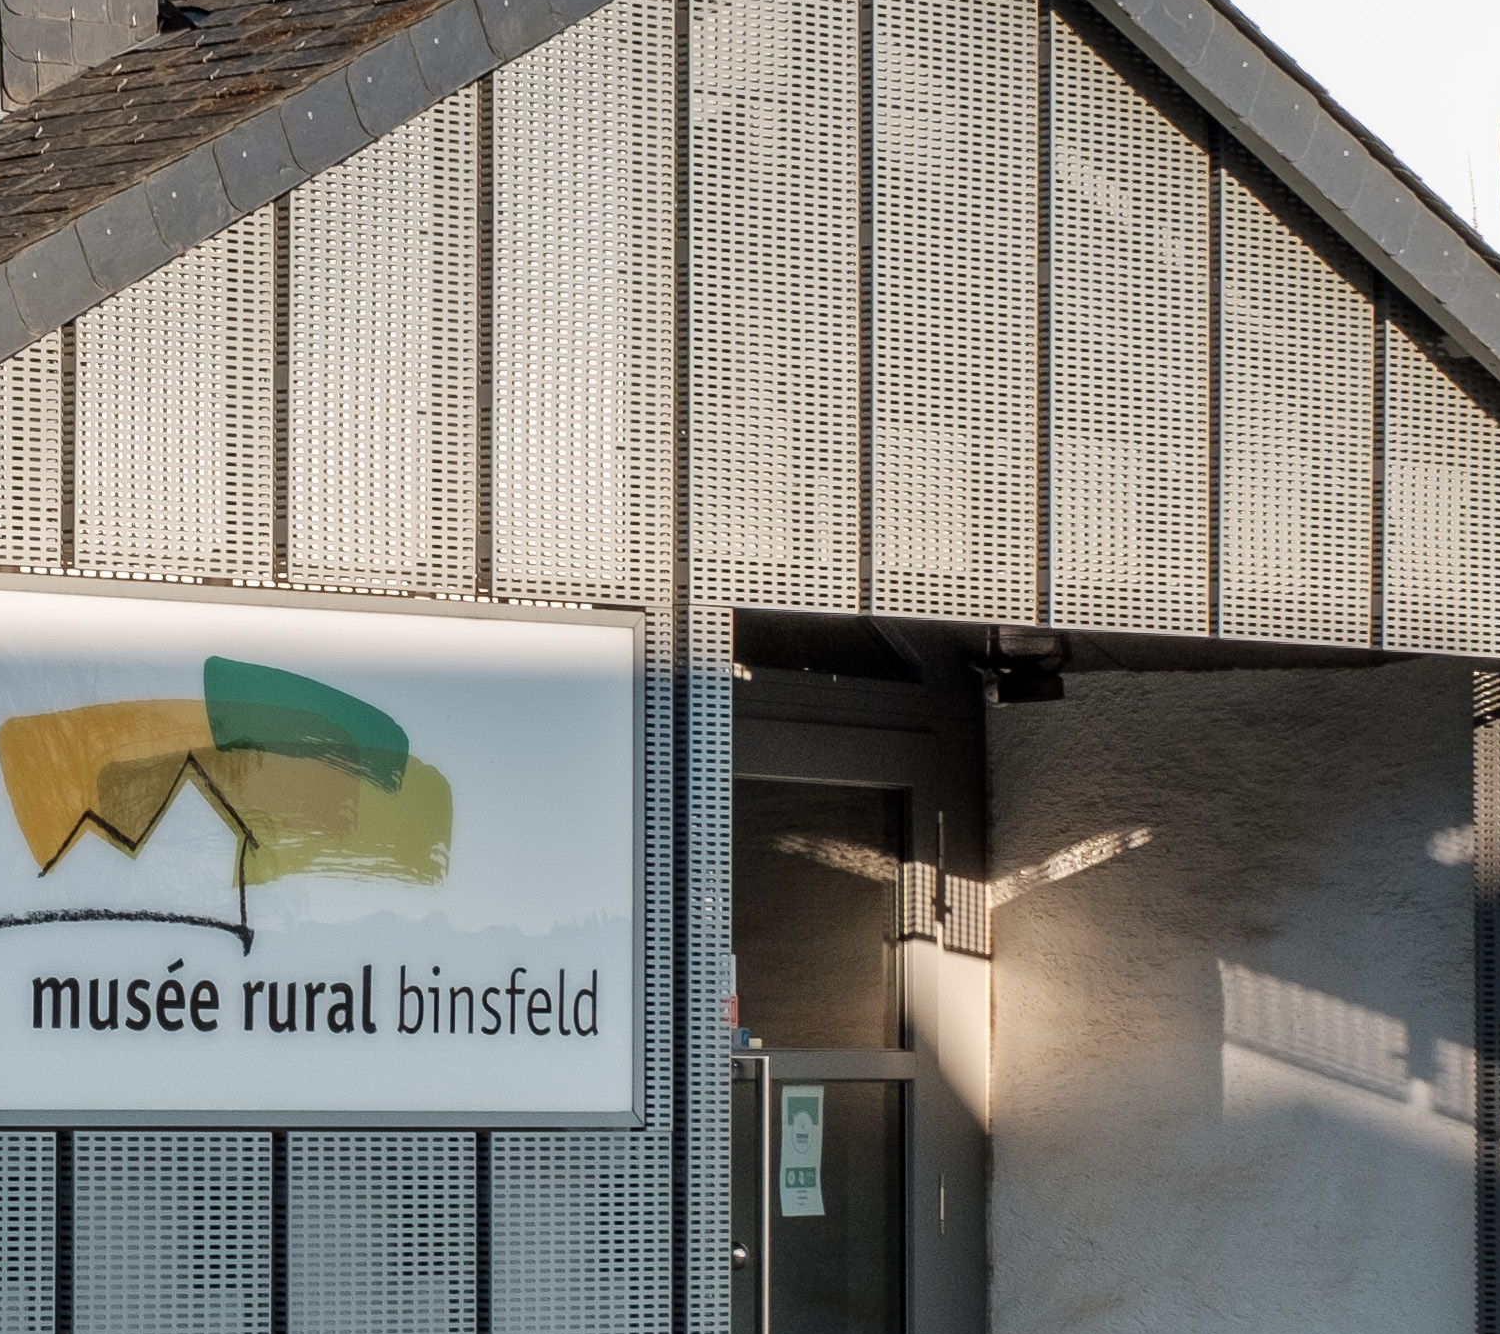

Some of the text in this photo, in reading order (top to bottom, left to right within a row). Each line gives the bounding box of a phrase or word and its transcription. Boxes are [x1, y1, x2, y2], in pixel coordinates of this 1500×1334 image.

[31, 958, 599, 1037] musée rural binsfeld
